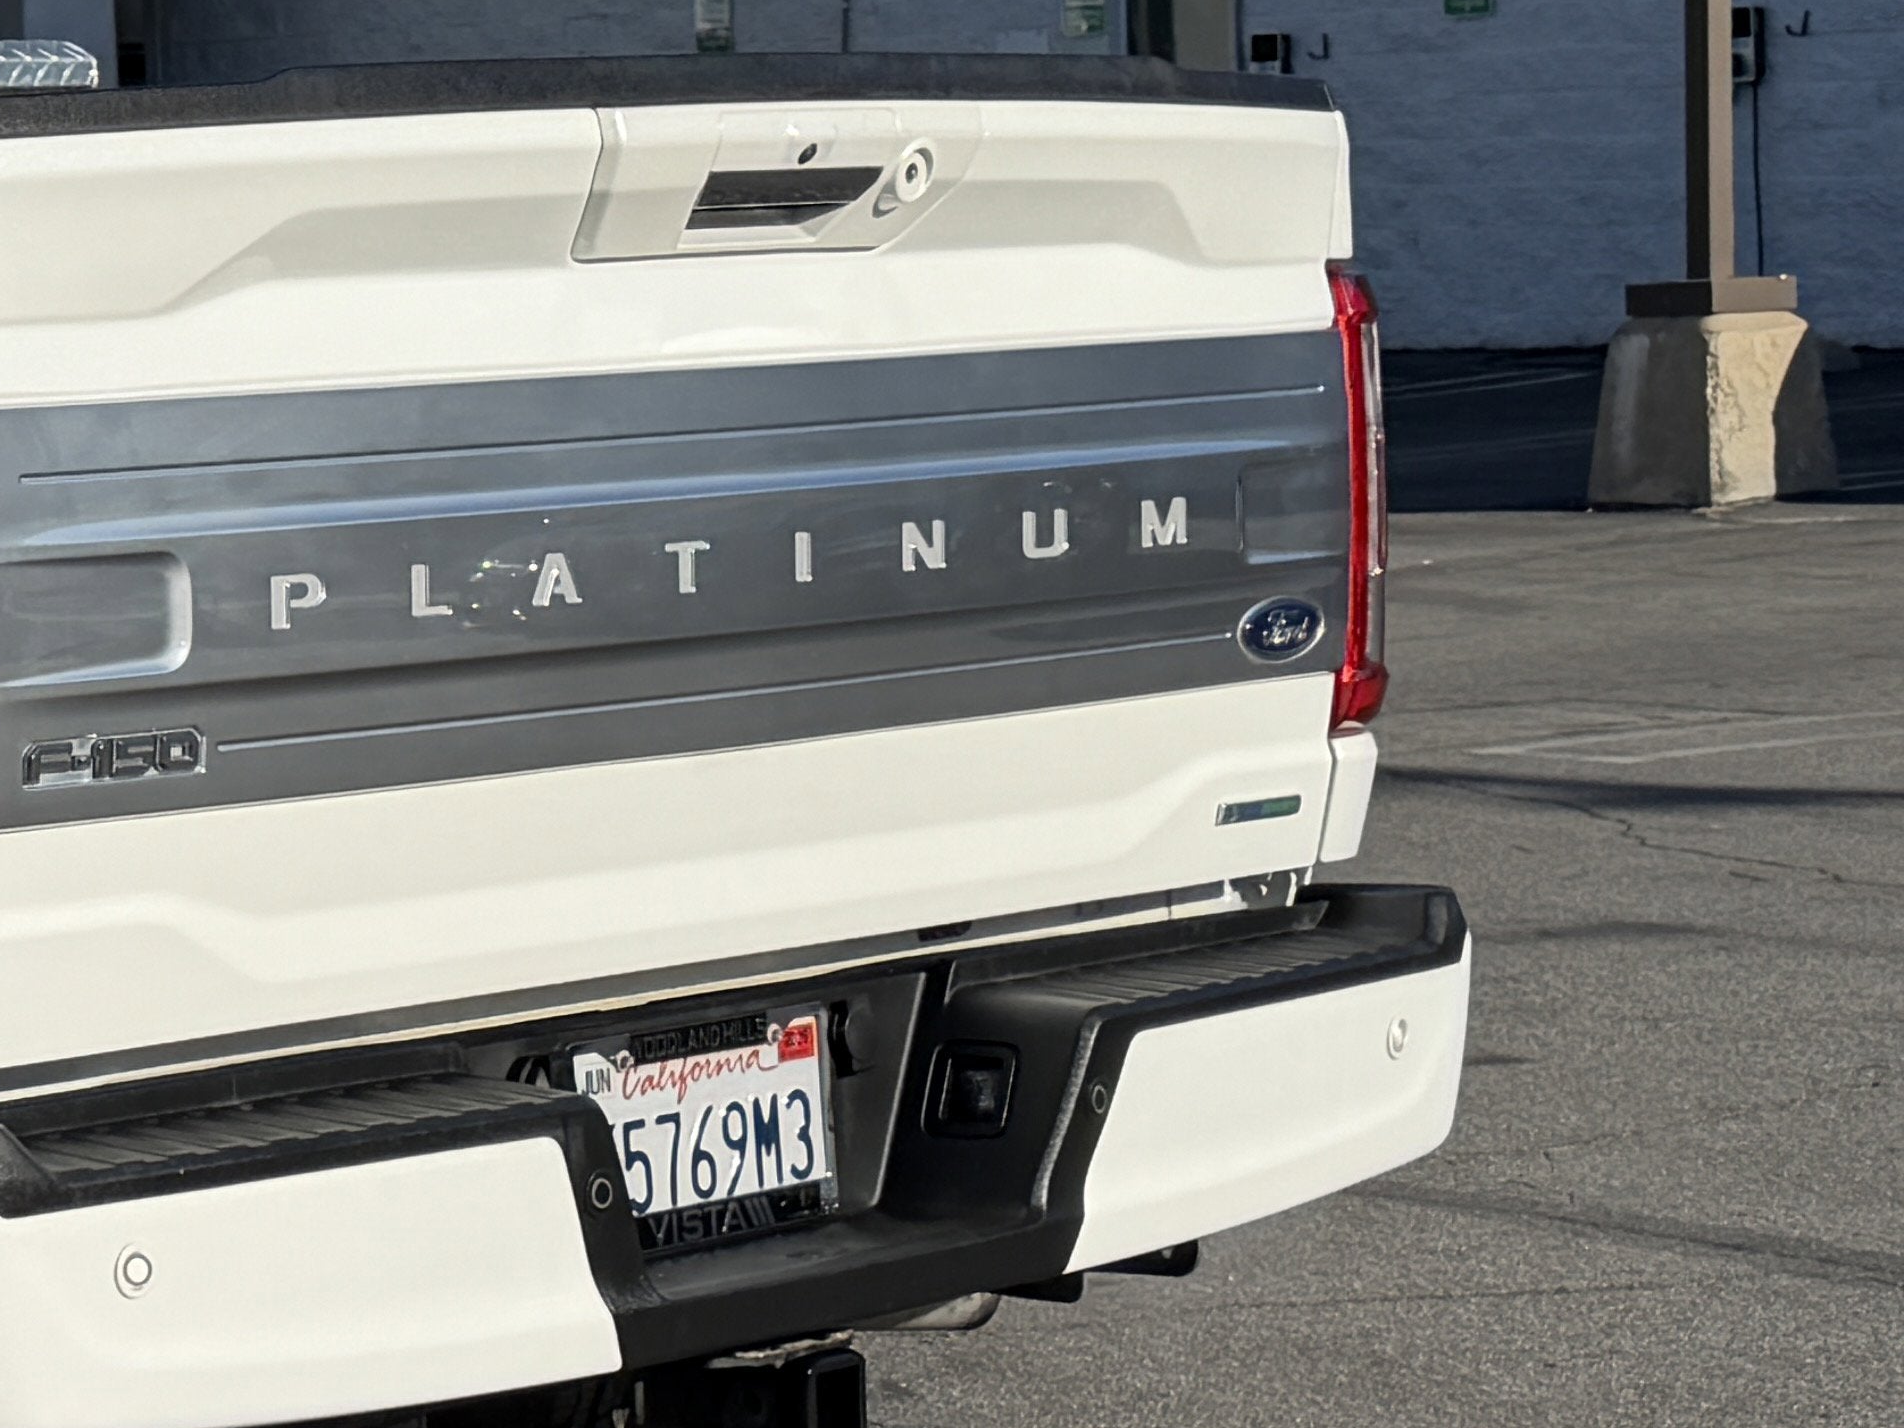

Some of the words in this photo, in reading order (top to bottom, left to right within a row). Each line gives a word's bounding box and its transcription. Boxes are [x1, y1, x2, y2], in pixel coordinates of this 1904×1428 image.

[269, 495, 1188, 631] PLATINUM
[21, 726, 206, 790] F-150
[581, 1067, 611, 1094] JUN
[622, 1047, 779, 1104] California
[608, 1088, 815, 1215] 5769M3
[647, 1200, 748, 1246] VISTA
